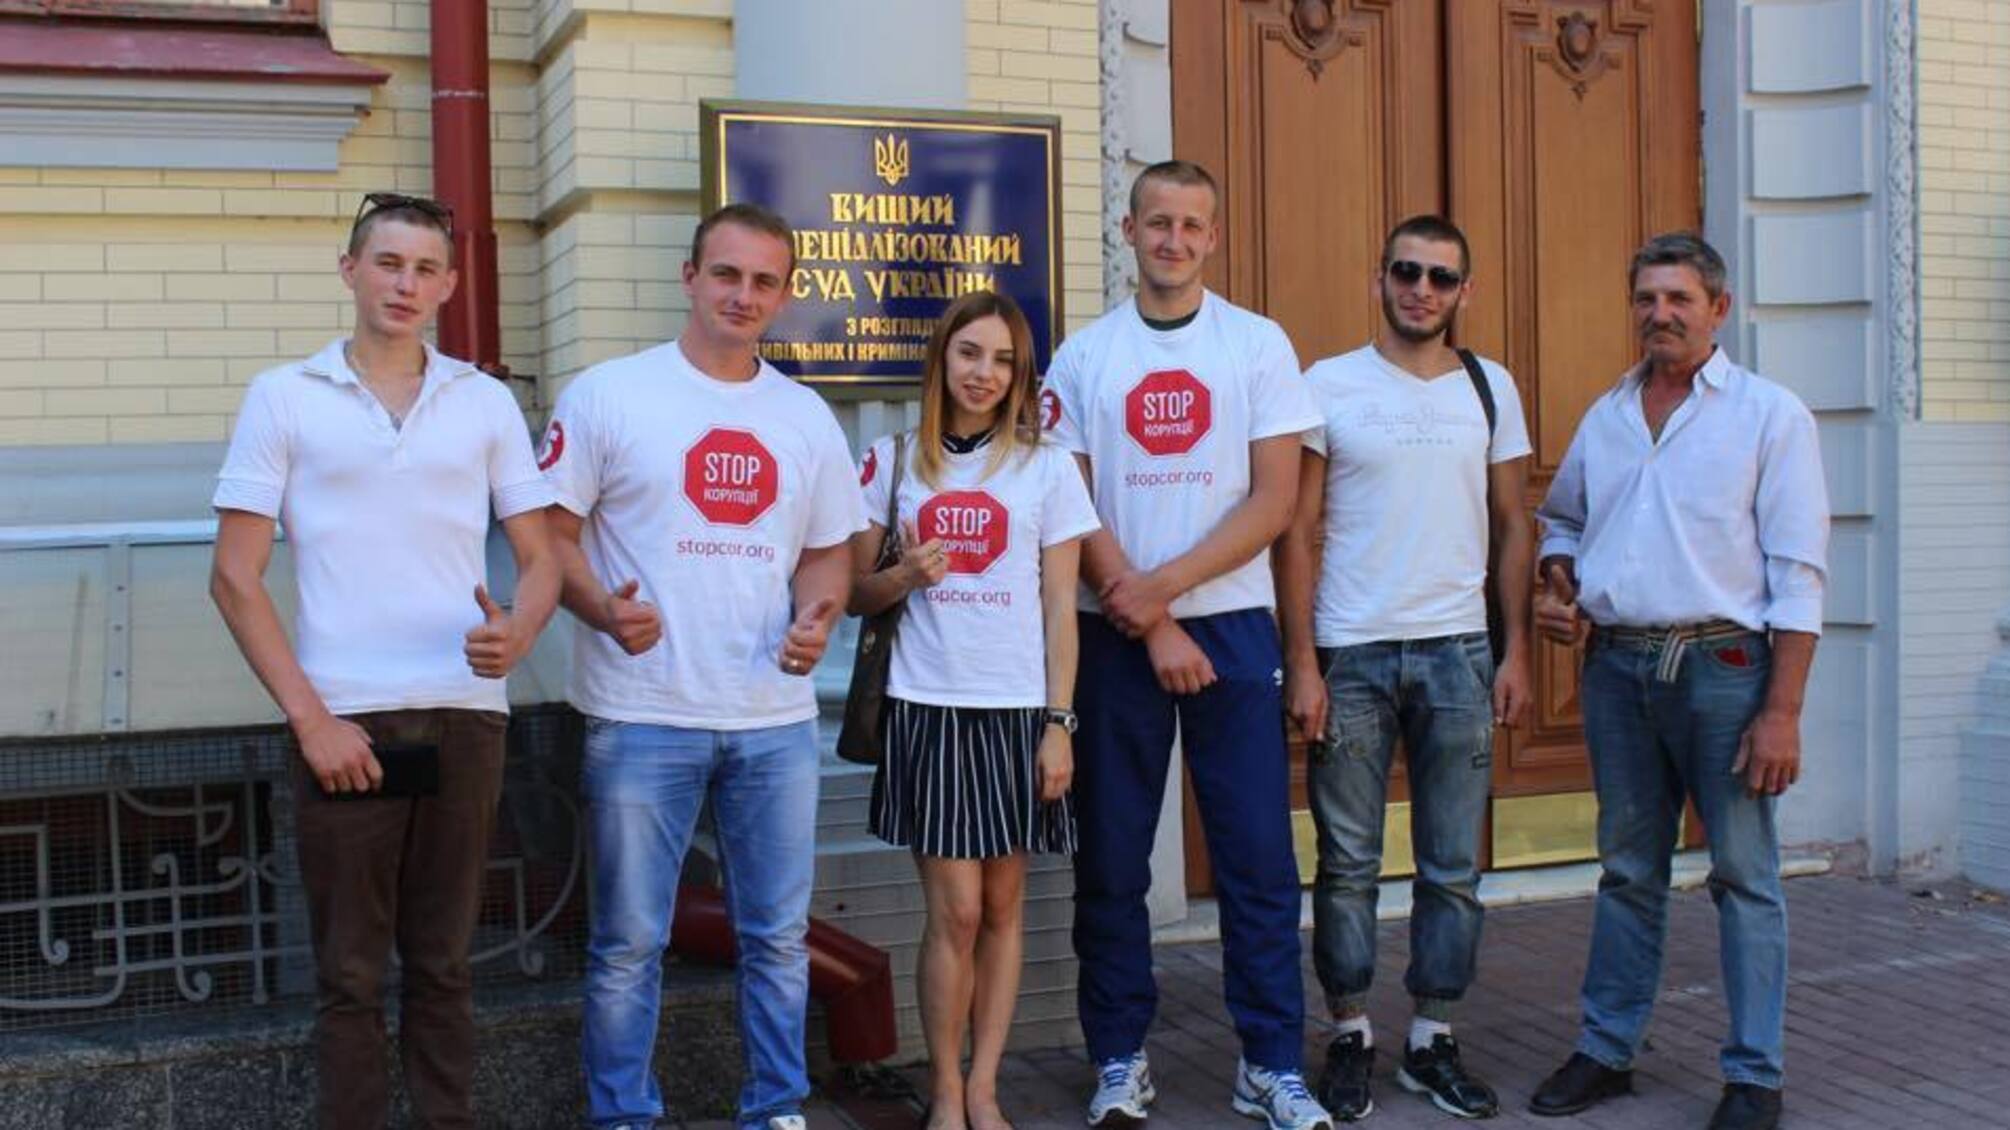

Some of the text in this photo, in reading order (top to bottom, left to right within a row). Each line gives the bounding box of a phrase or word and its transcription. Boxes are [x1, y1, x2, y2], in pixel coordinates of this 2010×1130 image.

[829, 192, 955, 227] ВИЩИЙ
[792, 227, 1023, 265] ЕЦІАЛІЗОВАНИЙ
[791, 267, 995, 303] СУД УКРАЇНИ
[846, 317, 857, 337] З
[756, 342, 846, 362] ИВІЛЬНИХ
[1143, 389, 1195, 421] STOP
[704, 452, 761, 486] STOP
[1124, 469, 1214, 487] stopcor.org
[935, 507, 992, 536] STOP
[676, 539, 776, 562] stopcor.org
[943, 538, 991, 555] ОРУПЦІЇ
[928, 588, 1012, 607] opcor.org
